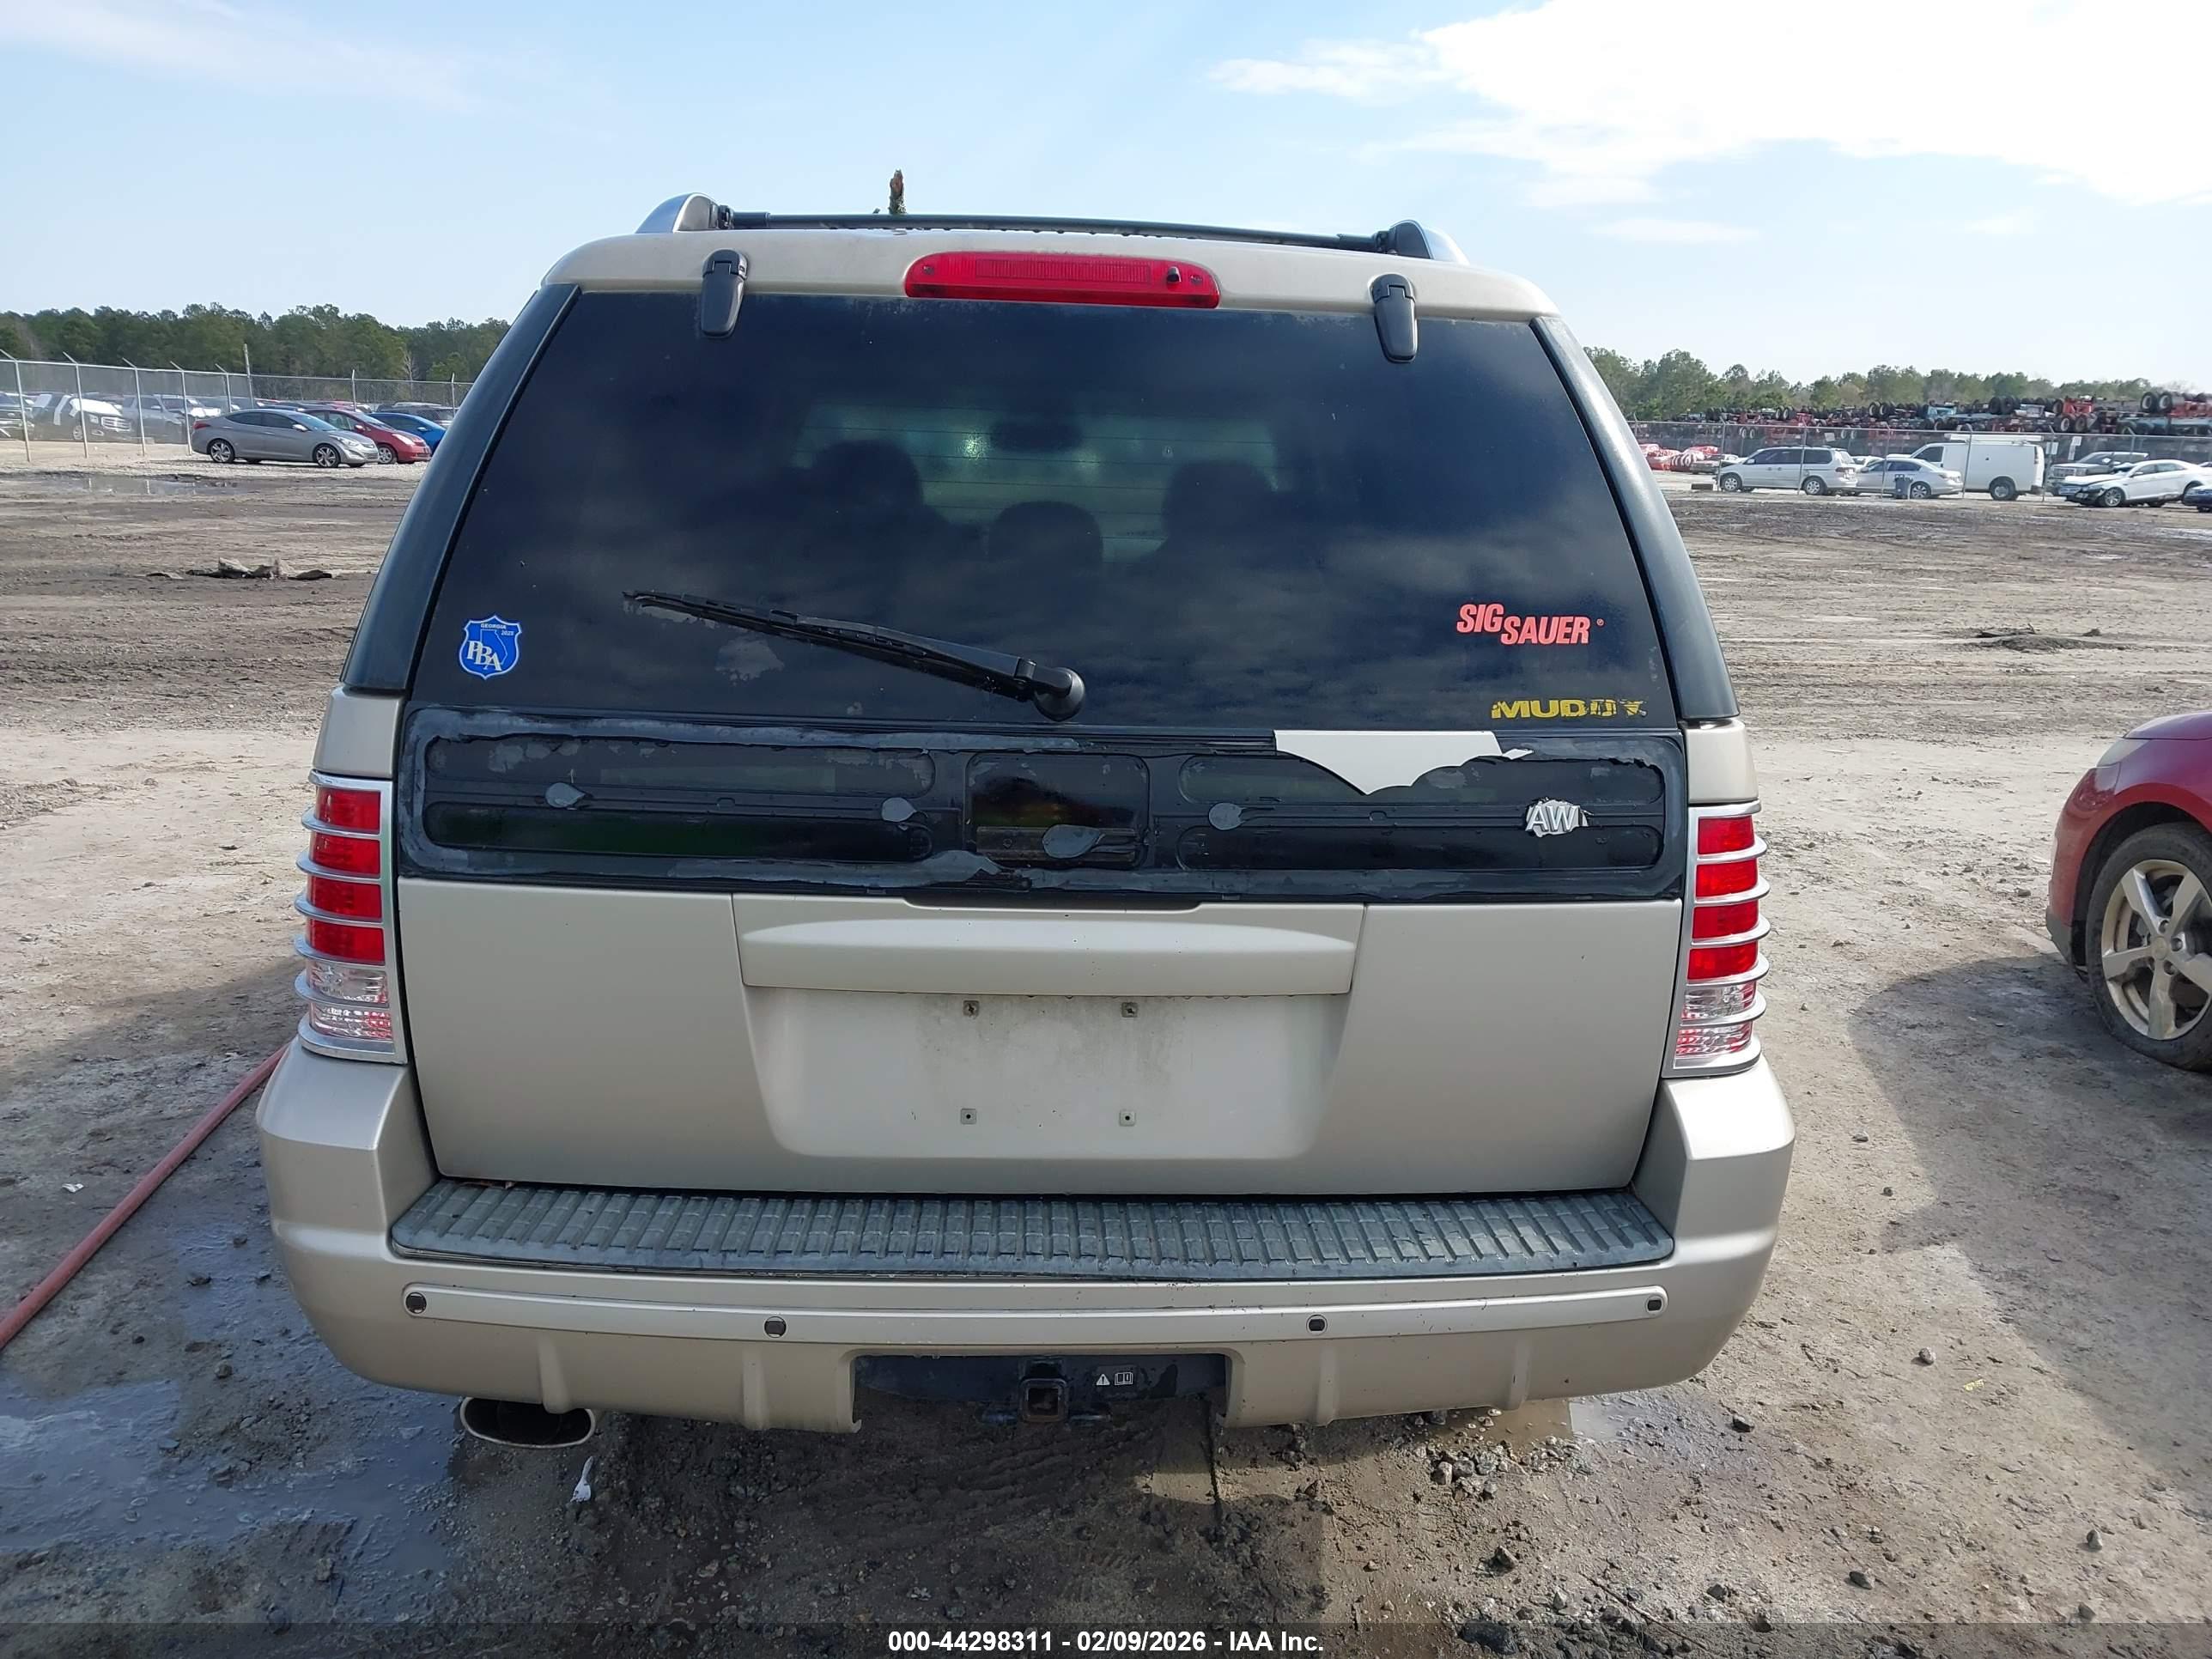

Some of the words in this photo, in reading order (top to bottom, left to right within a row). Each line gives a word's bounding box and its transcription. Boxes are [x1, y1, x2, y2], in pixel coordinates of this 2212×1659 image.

[1456, 604, 1504, 633] SIG
[1500, 616, 1590, 645] SAUER
[466, 640, 502, 672] PBA
